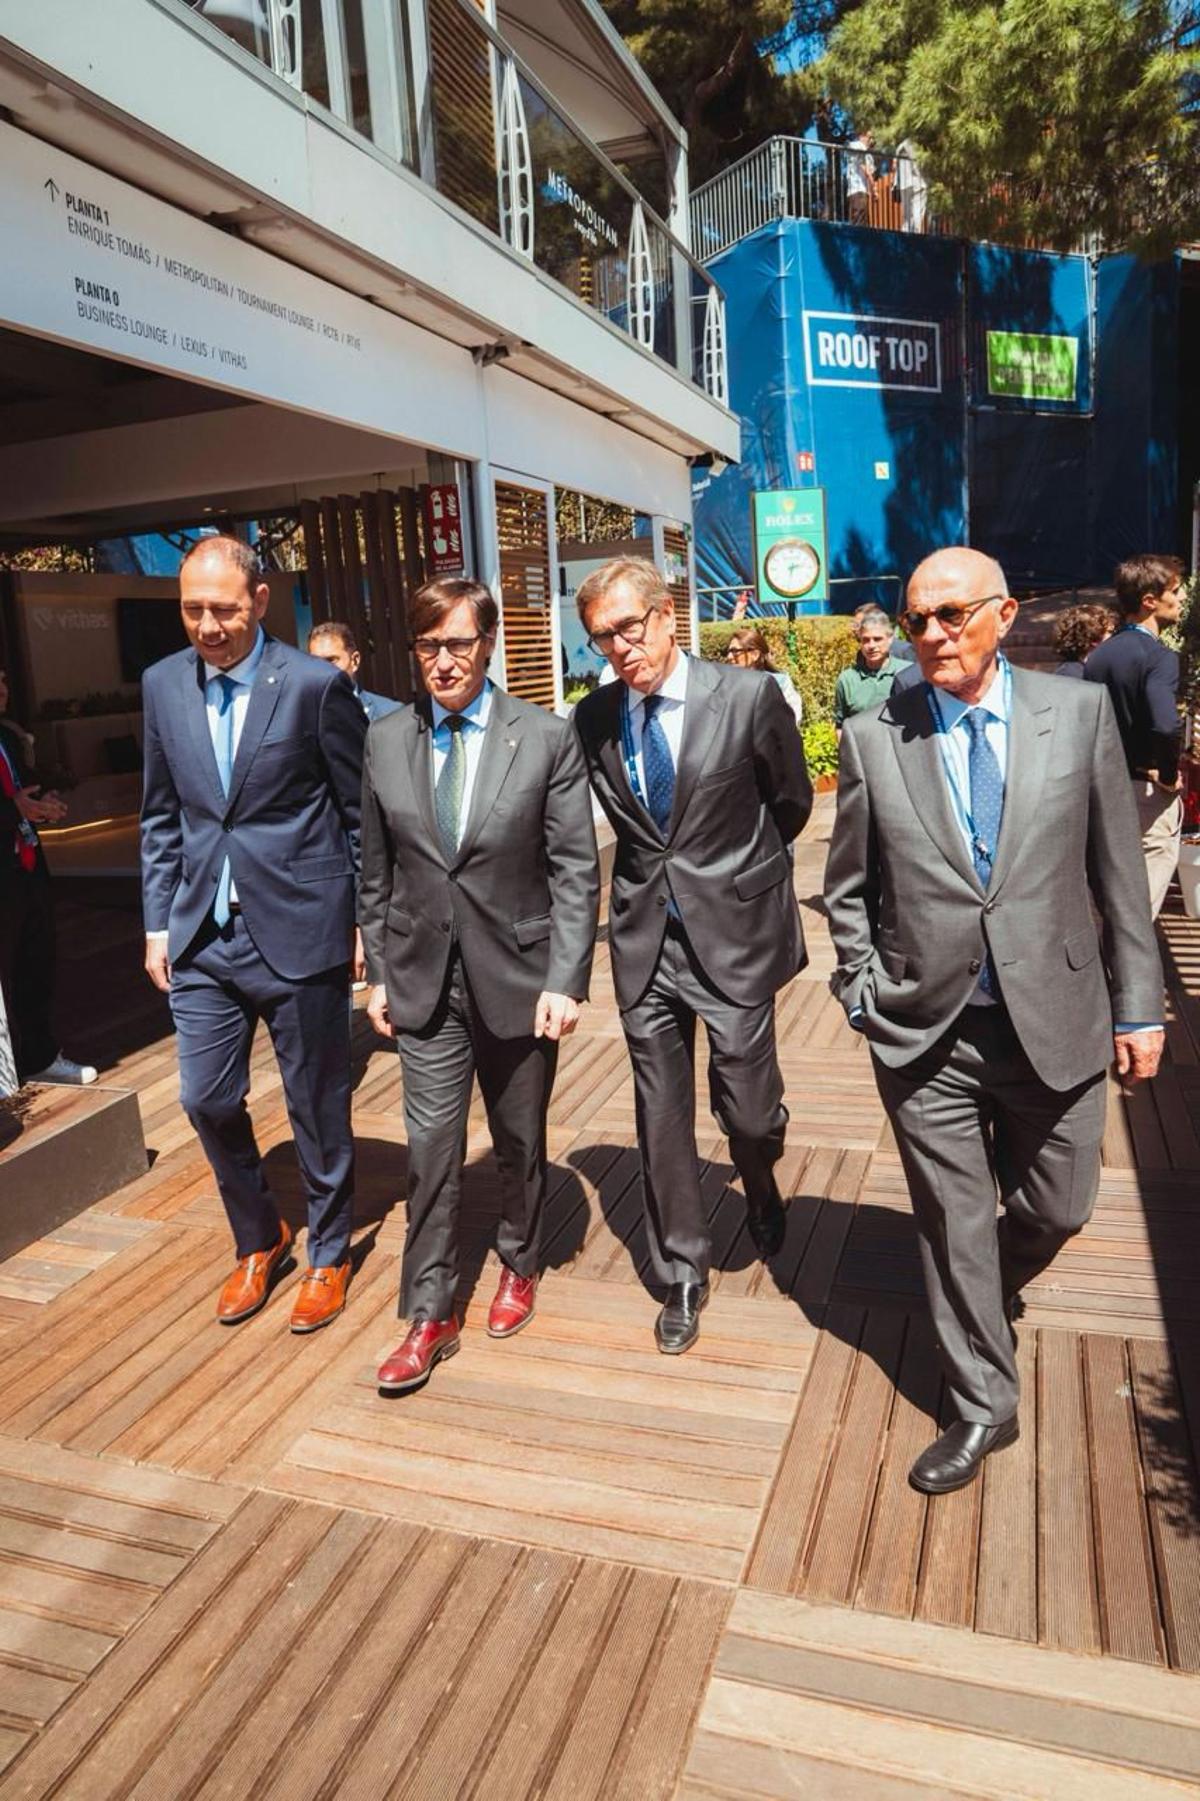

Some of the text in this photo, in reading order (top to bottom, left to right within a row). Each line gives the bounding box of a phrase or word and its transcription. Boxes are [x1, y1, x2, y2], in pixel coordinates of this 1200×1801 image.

[66, 192, 109, 226] PLANTA 1
[547, 168, 618, 248] METROPOLITAN
[68, 216, 114, 250] ENRIQUE
[116, 237, 151, 265] TOMÁS
[164, 258, 229, 297] METROPOLITAN
[237, 288, 287, 320] TOURNAMENT
[288, 311, 314, 332] LOUNGE
[75, 277, 119, 306] PLANTA 0
[77, 301, 128, 332] BUSINESS
[129, 319, 168, 345] LOUNGE
[180, 336, 207, 357] LEXUS
[218, 348, 247, 370] VITHAS
[818, 331, 928, 372] ROOF TOP
[765, 514, 815, 527] ROLEX
